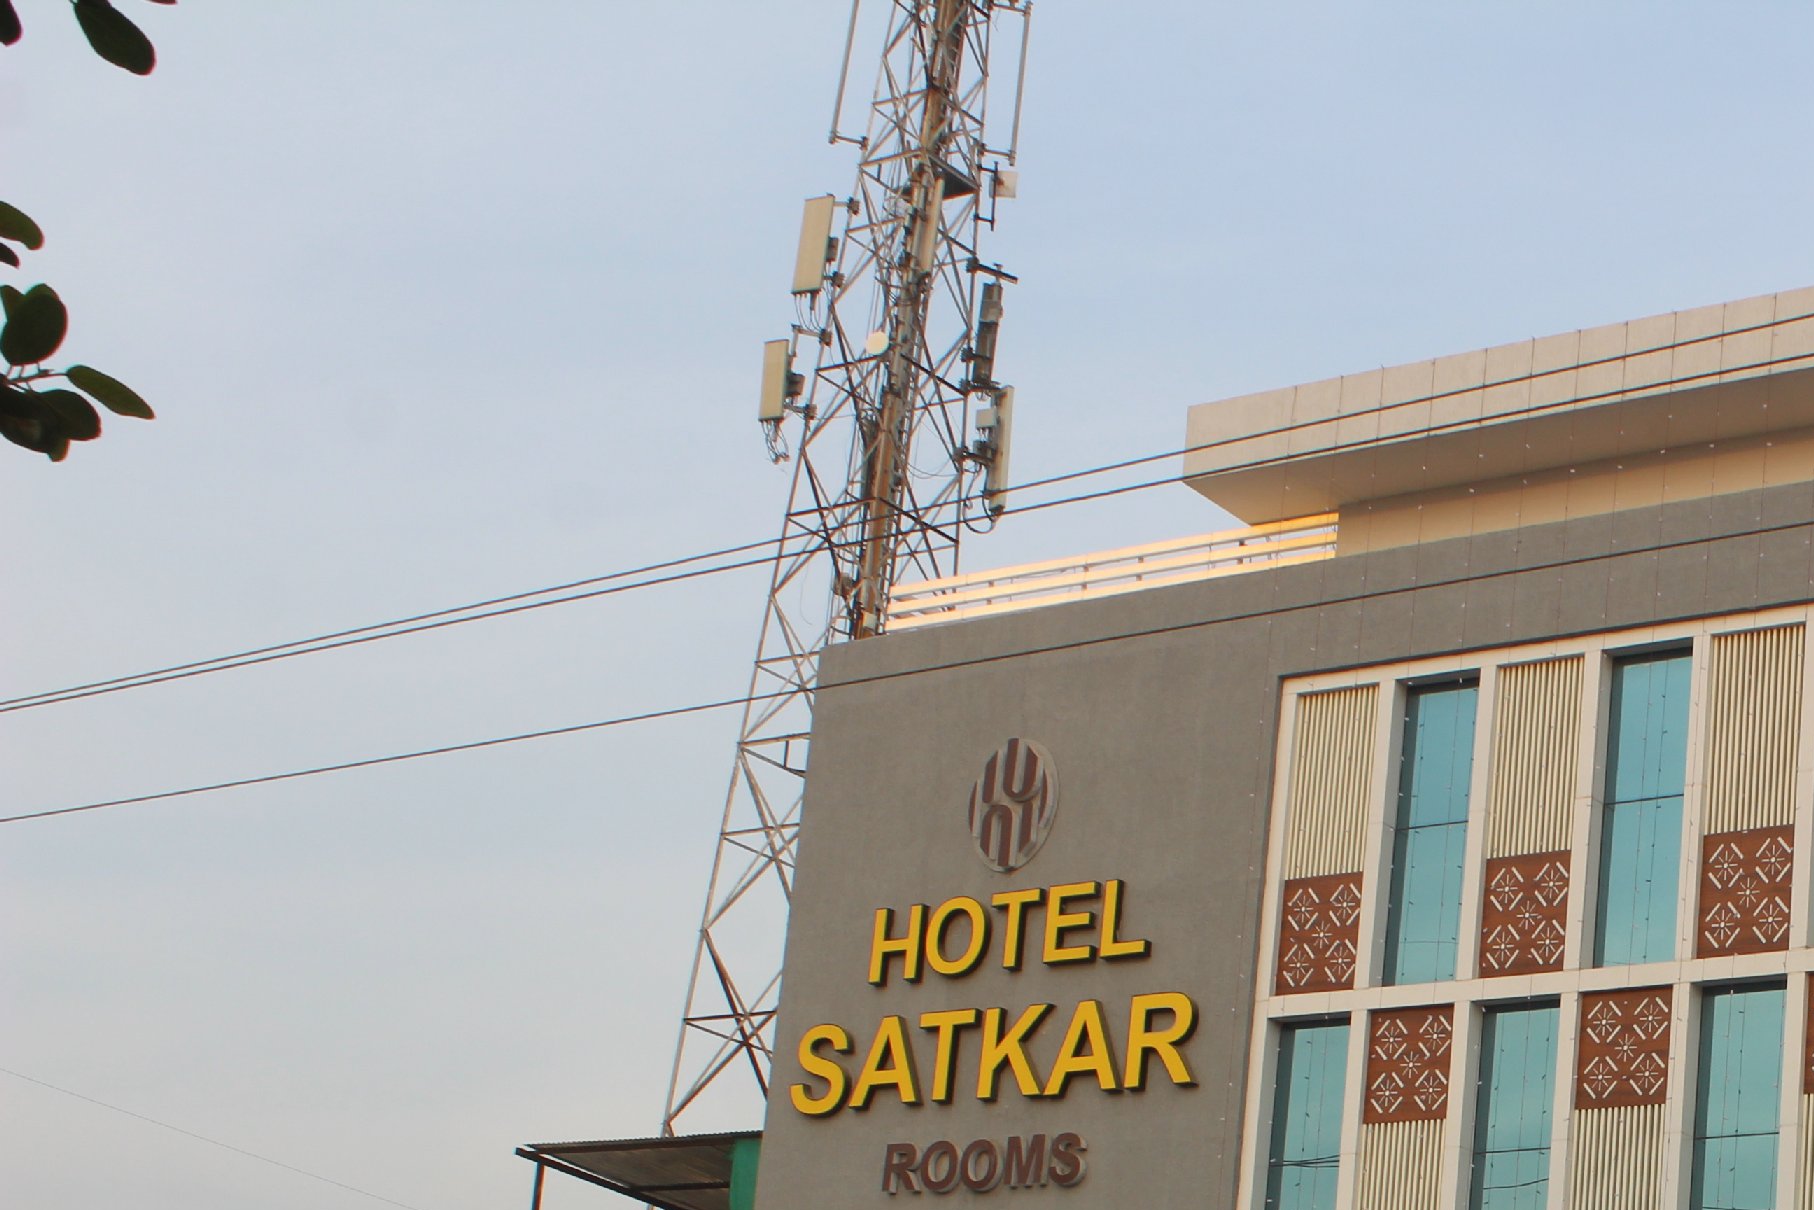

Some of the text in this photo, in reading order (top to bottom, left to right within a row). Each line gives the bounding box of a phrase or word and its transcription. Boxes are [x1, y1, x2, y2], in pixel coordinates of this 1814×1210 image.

[868, 879, 1151, 986] HOTEL
[789, 991, 1198, 1116] SATKAR
[882, 1133, 1088, 1195] ROOMS
